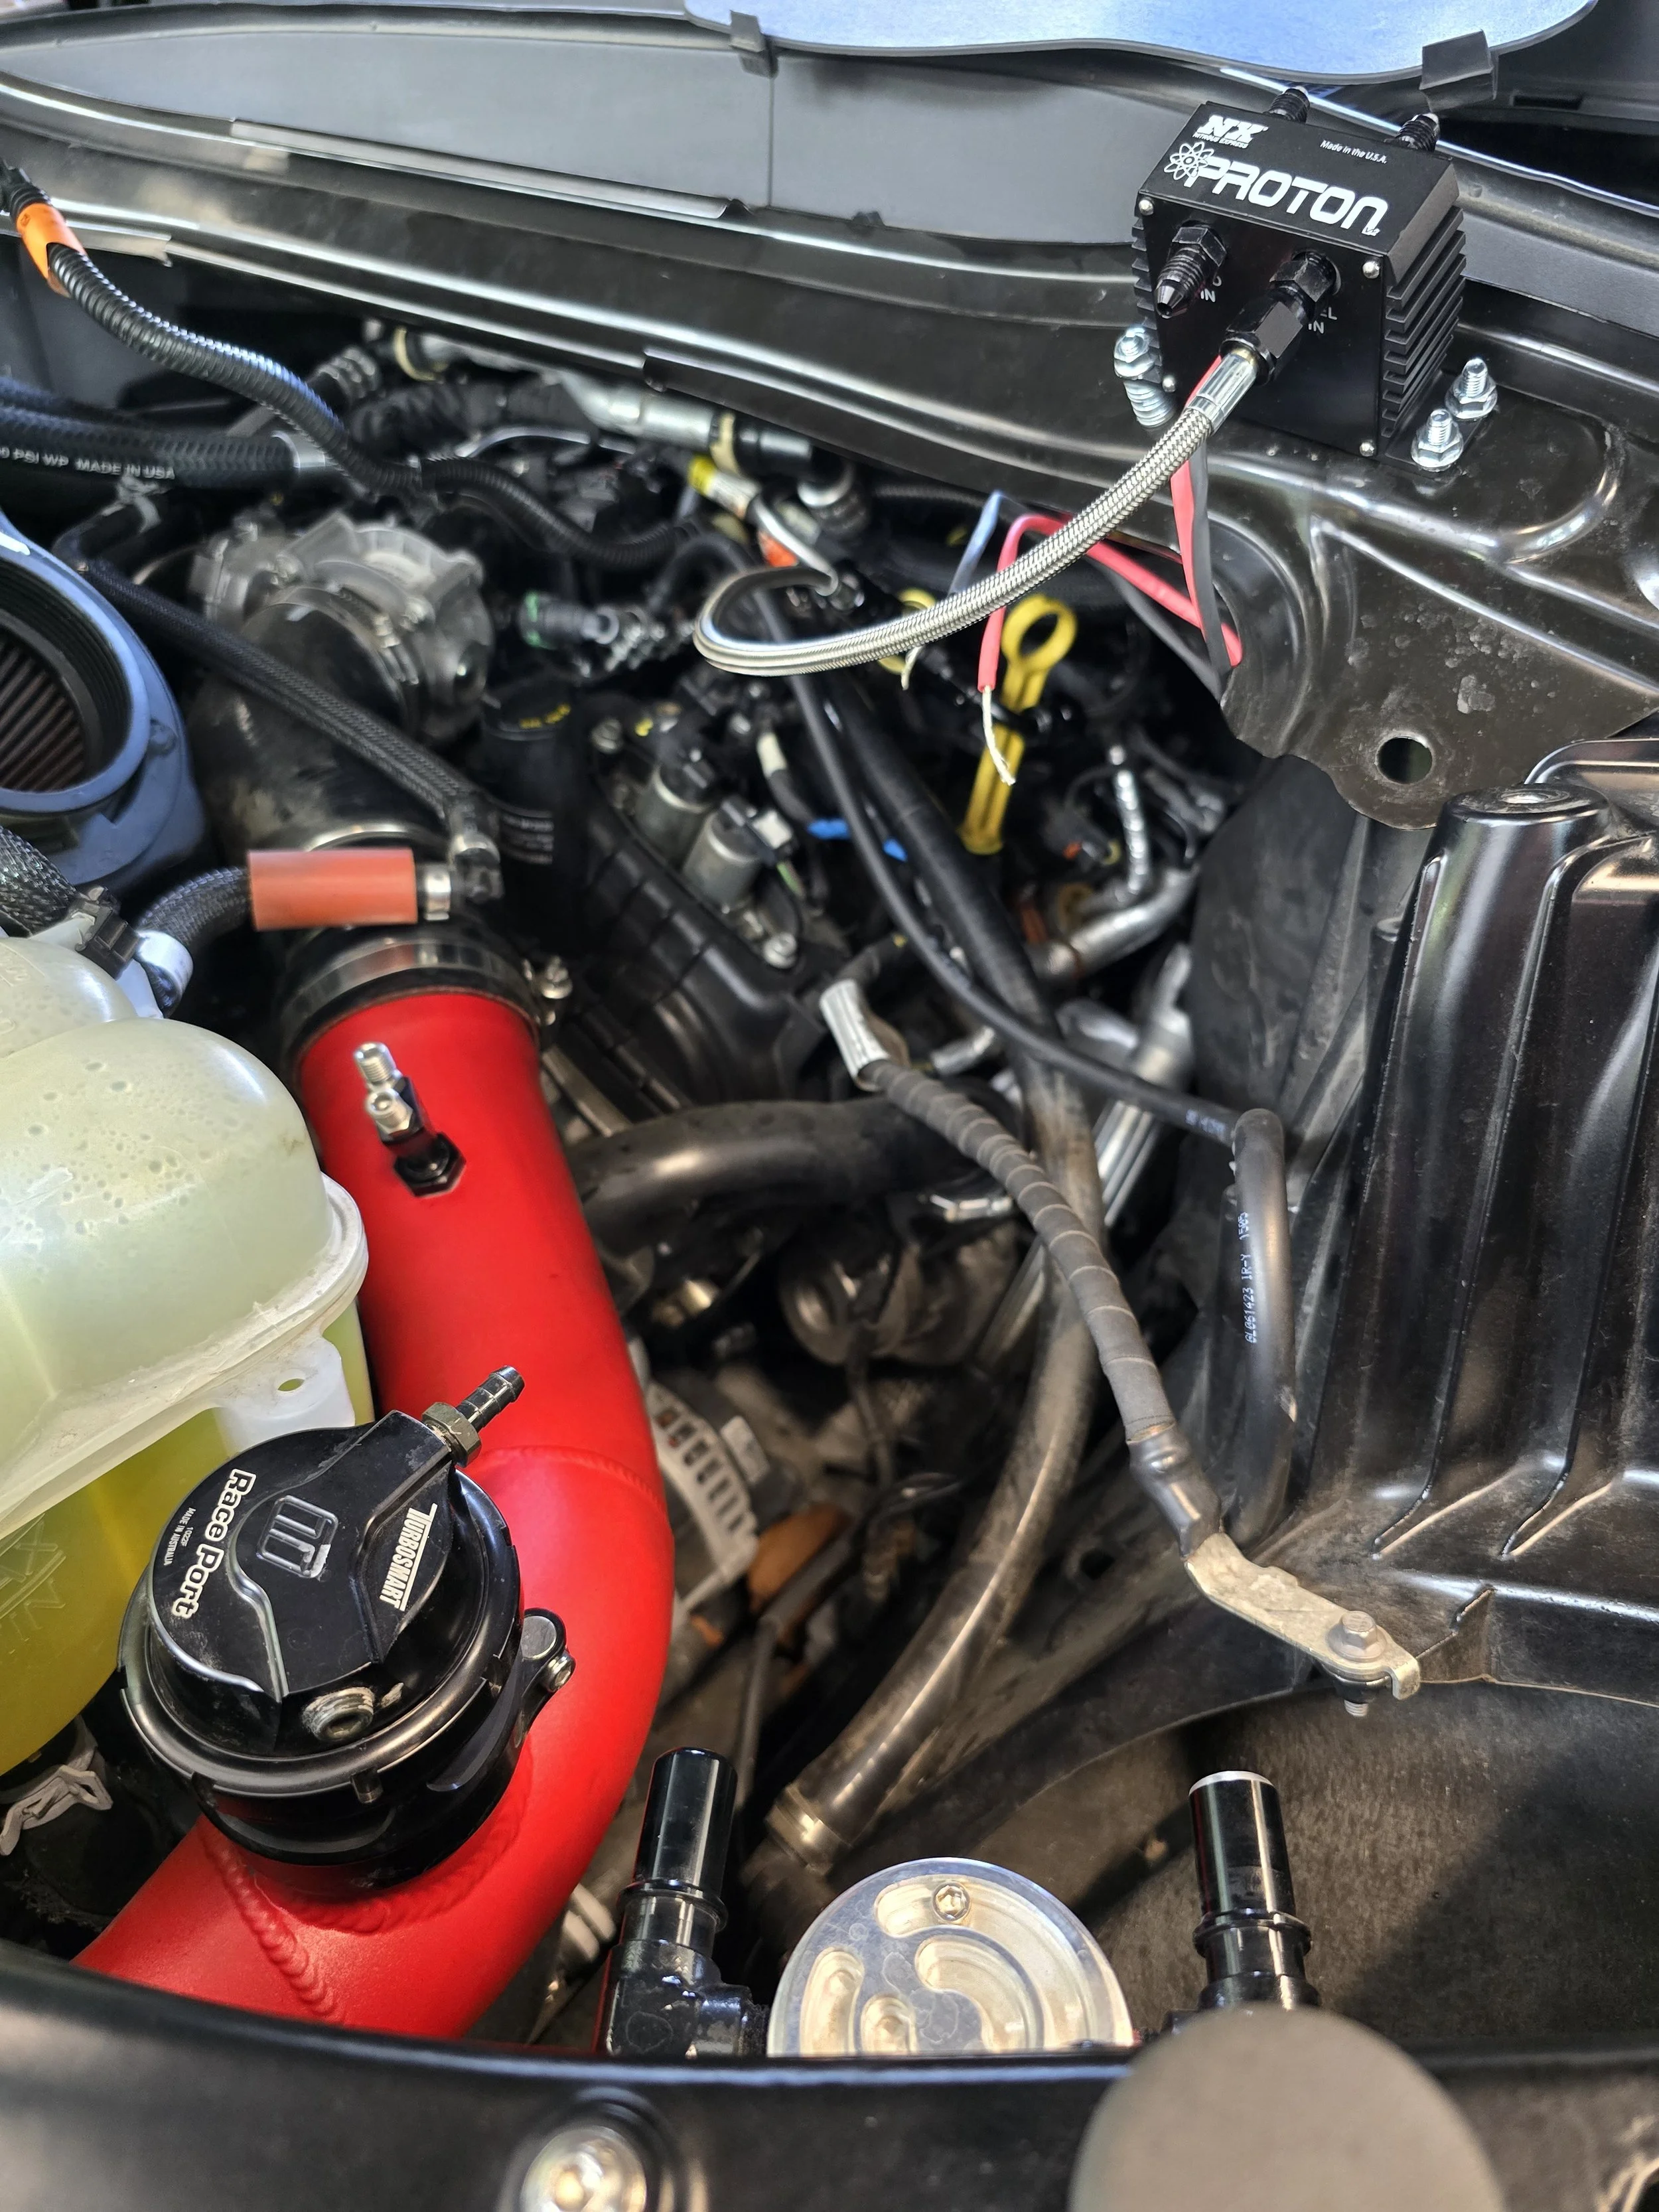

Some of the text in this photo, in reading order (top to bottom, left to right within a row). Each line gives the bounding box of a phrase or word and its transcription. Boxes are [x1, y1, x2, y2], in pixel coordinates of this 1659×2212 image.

[1196, 115, 1266, 144] NX
[1320, 140, 1388, 164] Made in the U.S.A.
[1200, 288, 1216, 303] IN
[1308, 320, 1325, 334] IN
[13, 447, 39, 464] PSI
[42, 453, 69, 467] WP
[74, 457, 122, 475] MADE
[124, 463, 141, 477] IN
[141, 465, 175, 480] USA
[179, 1507, 196, 1524] MADE
[163, 1532, 181, 1566] AUSTRALIA
[172, 1468, 257, 1619] Race Port
[379, 1503, 438, 1612] TURBOSMART
